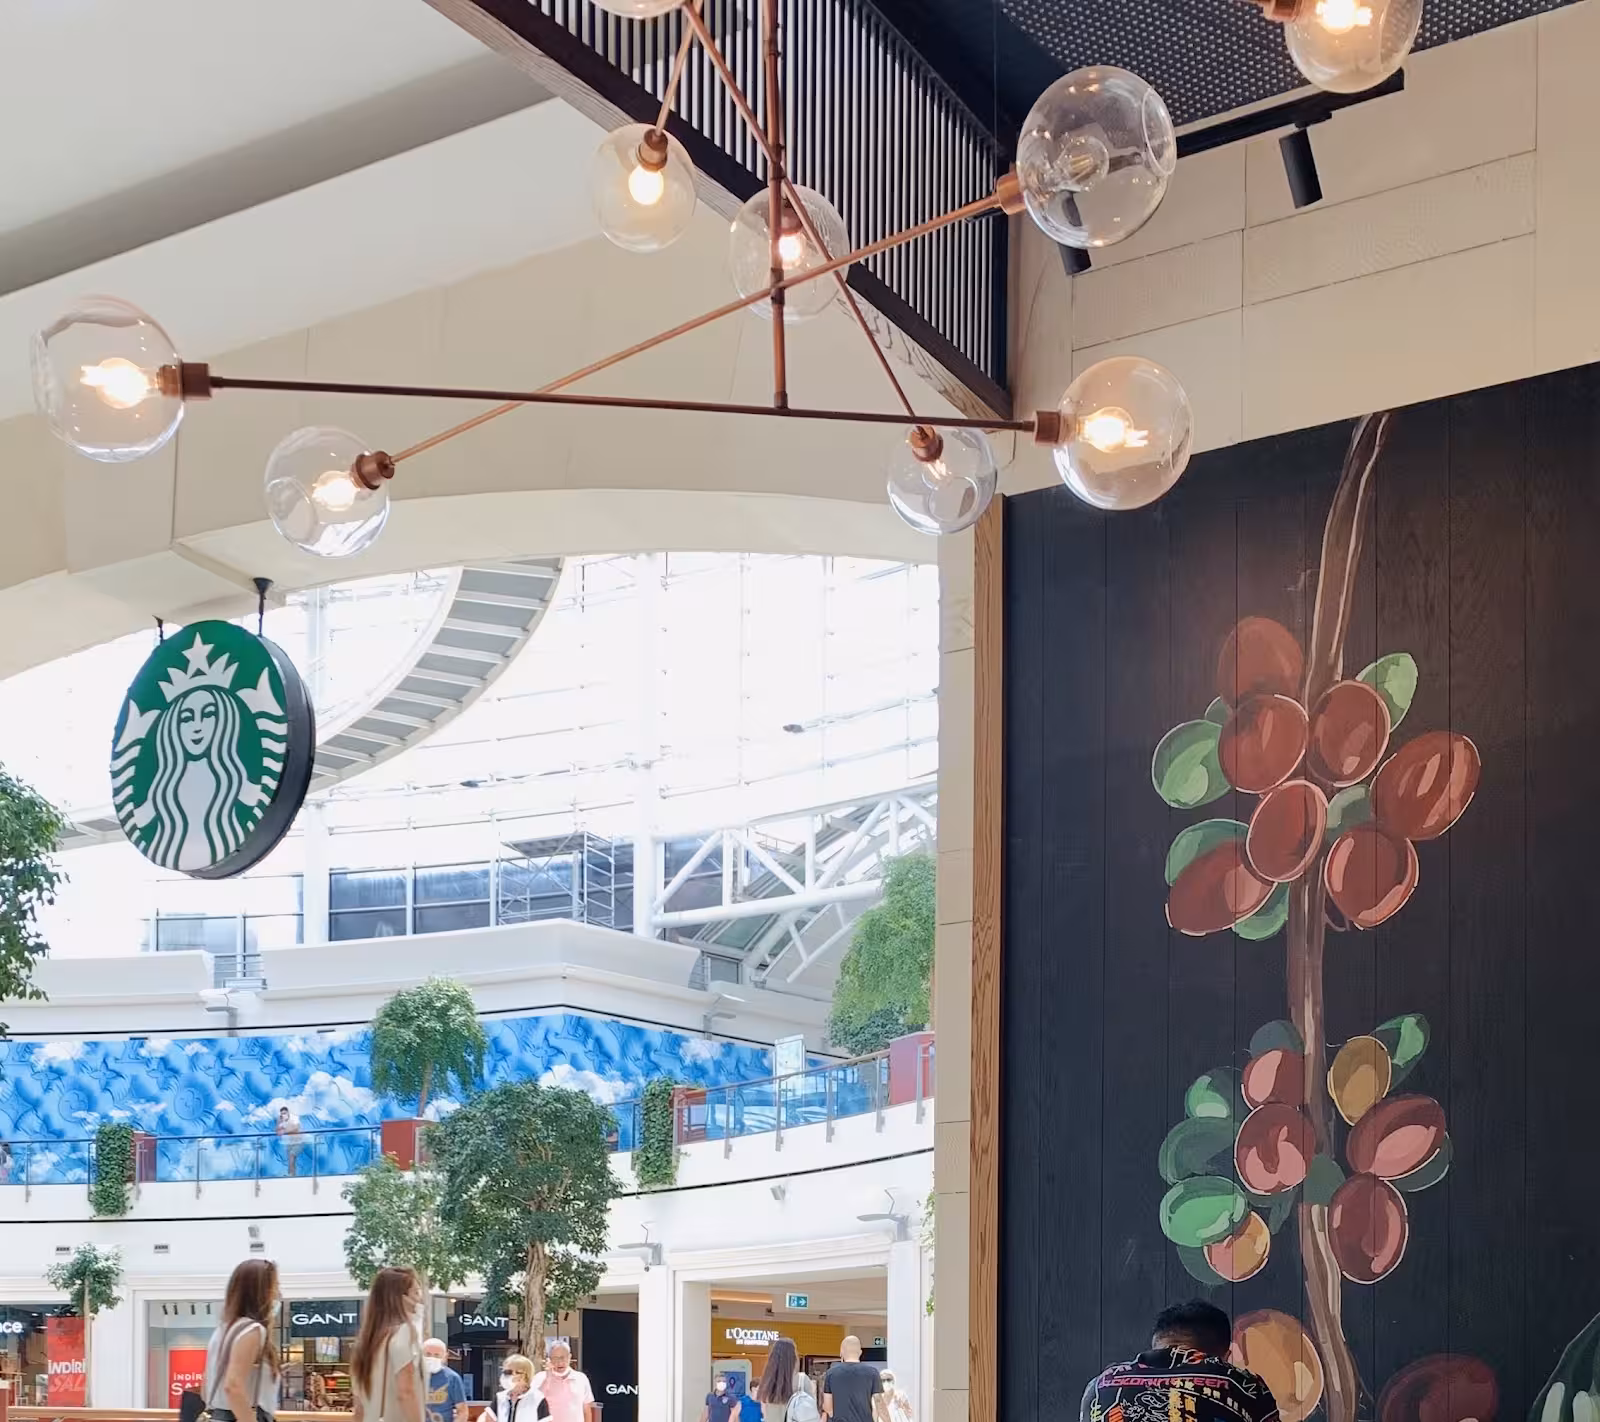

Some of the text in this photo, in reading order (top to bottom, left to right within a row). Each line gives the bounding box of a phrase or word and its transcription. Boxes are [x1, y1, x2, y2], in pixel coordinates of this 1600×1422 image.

[292, 1313, 357, 1325] GANT
[459, 1313, 508, 1327] GANT
[49, 1375, 86, 1392] SAL
[606, 1384, 639, 1395] GAN
